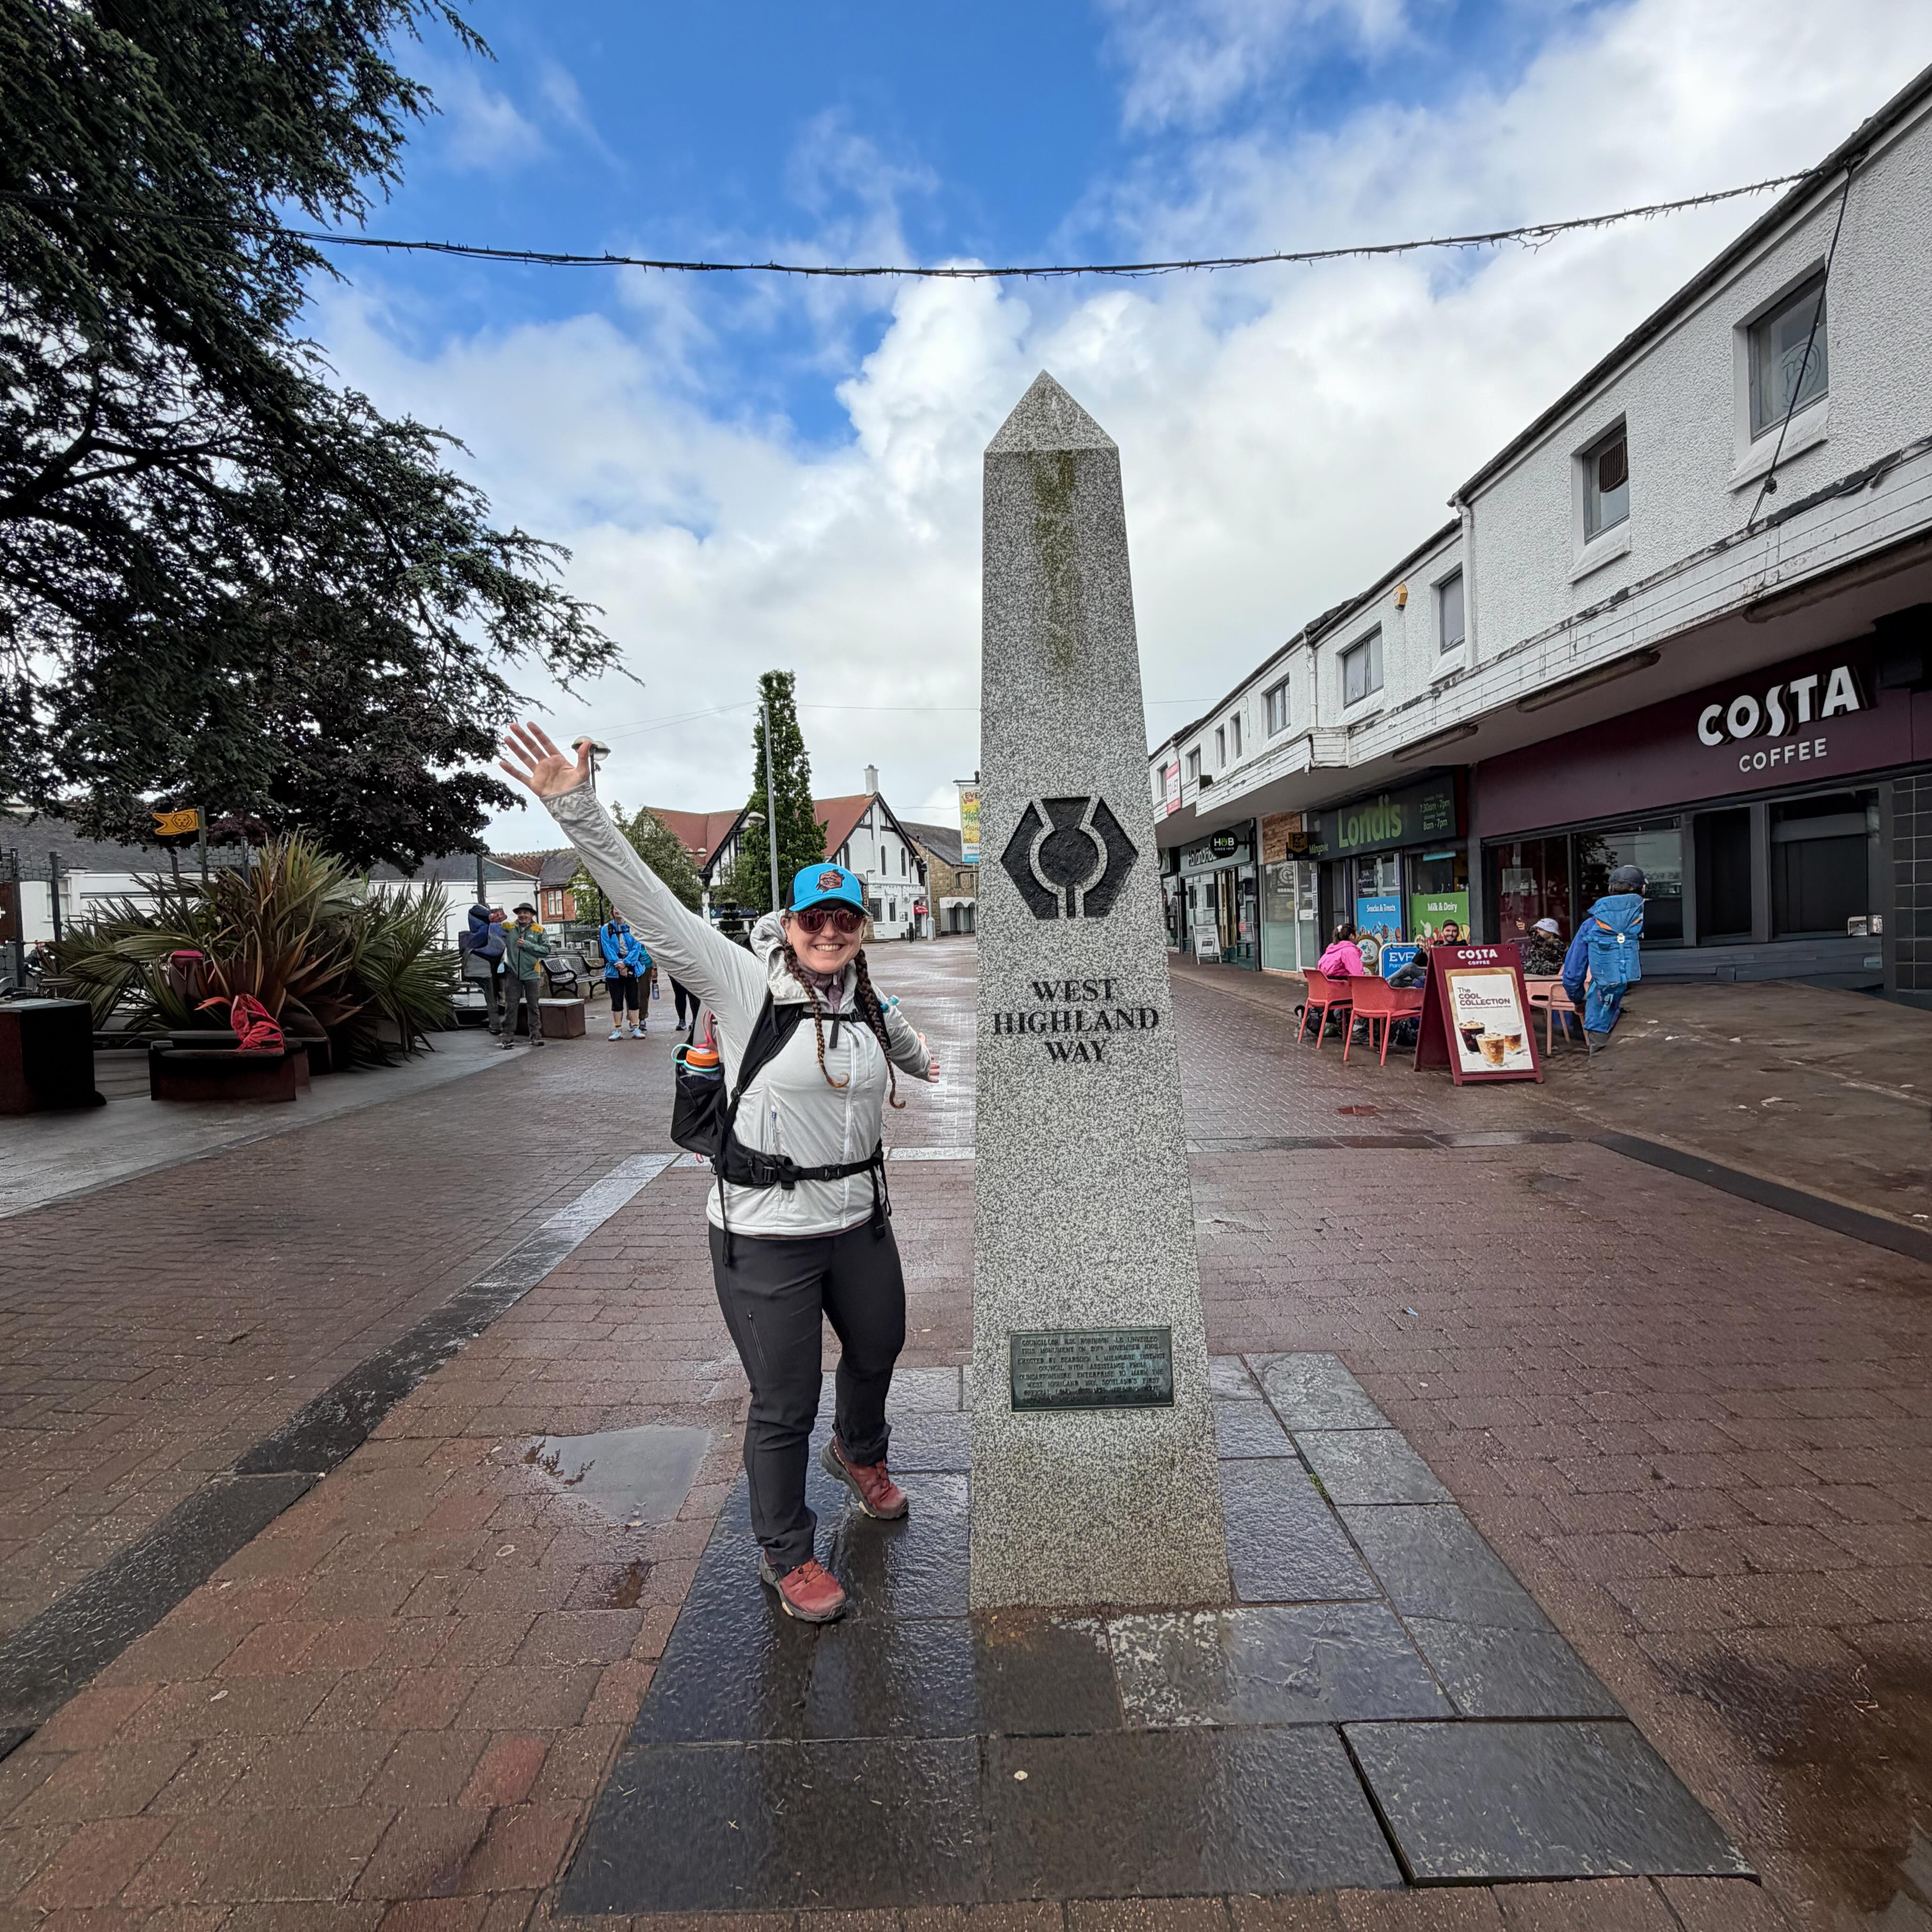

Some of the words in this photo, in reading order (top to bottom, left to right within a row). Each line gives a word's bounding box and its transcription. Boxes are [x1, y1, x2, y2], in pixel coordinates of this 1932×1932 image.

[1698, 666, 1860, 747] COSTA
[1739, 738, 1827, 772] COFFEE
[1338, 794, 1402, 848] Londis
[1436, 818, 1448, 829] 7pm
[1214, 837, 1234, 846] H&B
[1427, 902, 1439, 911] Milk
[1439, 902, 1443, 911] &
[1443, 902, 1457, 913] Dairy
[1389, 952, 1416, 961] EVR
[1457, 949, 1498, 959] COSTA
[1032, 978, 1117, 1002] WEST
[991, 1008, 1159, 1035] HIGHLAND
[1045, 1040, 1107, 1062] WAY
[1077, 1370, 1114, 1378] ENTERPRISE
